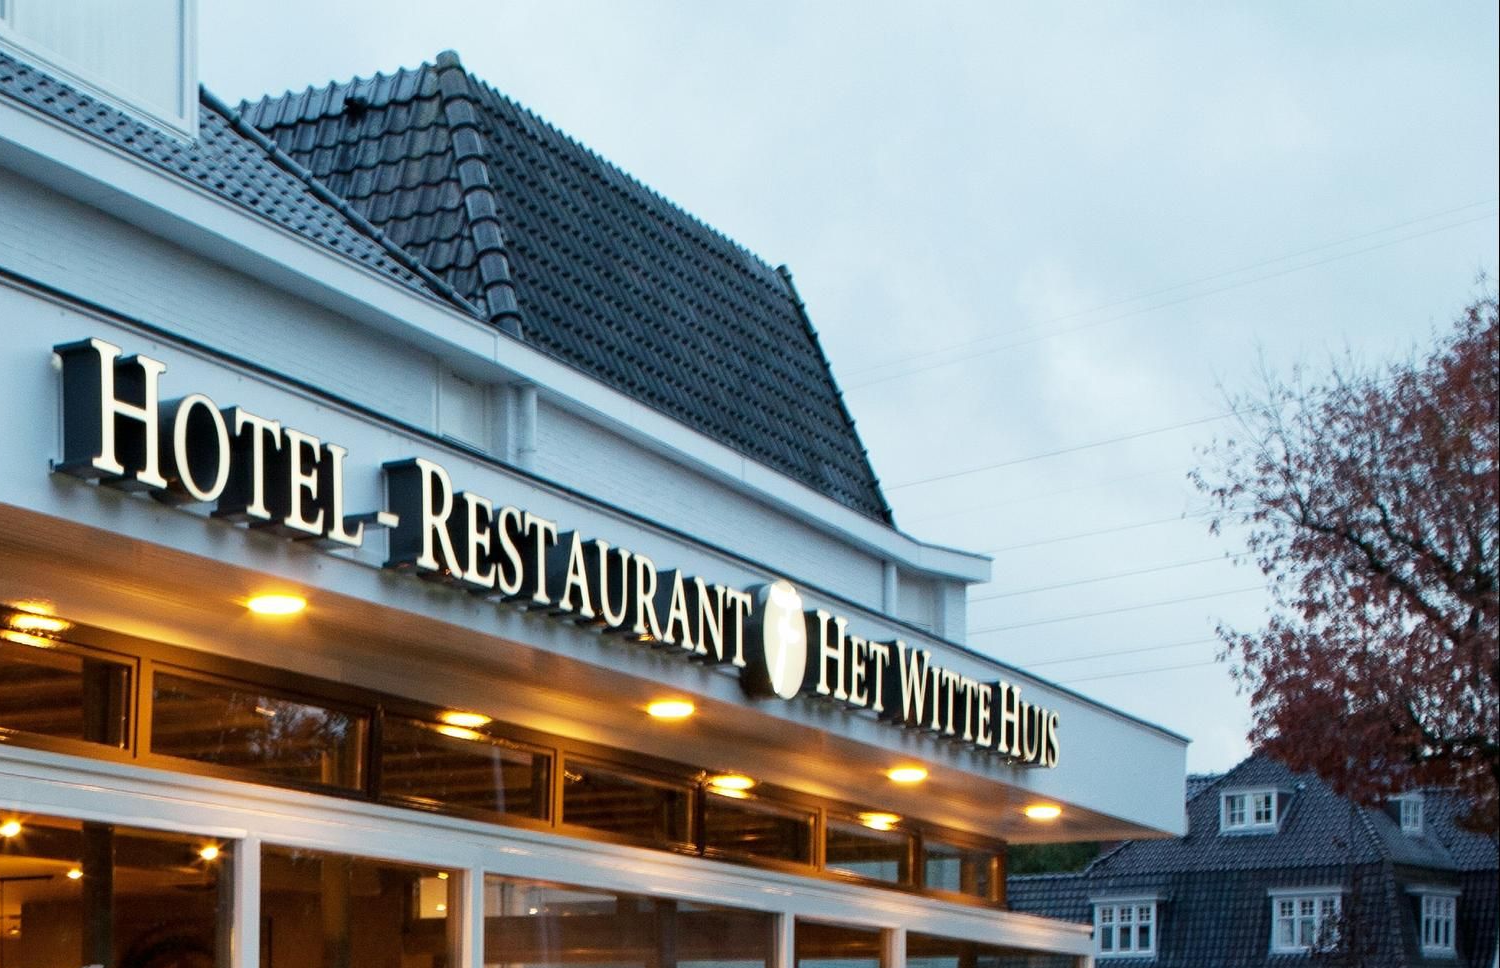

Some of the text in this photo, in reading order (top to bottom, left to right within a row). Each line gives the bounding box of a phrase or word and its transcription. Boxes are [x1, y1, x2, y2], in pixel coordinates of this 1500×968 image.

[92, 337, 364, 547] HOTEL
[415, 457, 753, 668] RESTAURANT
[816, 608, 890, 712] HET
[896, 640, 992, 747] WITTE
[997, 681, 1061, 769] HUIS
